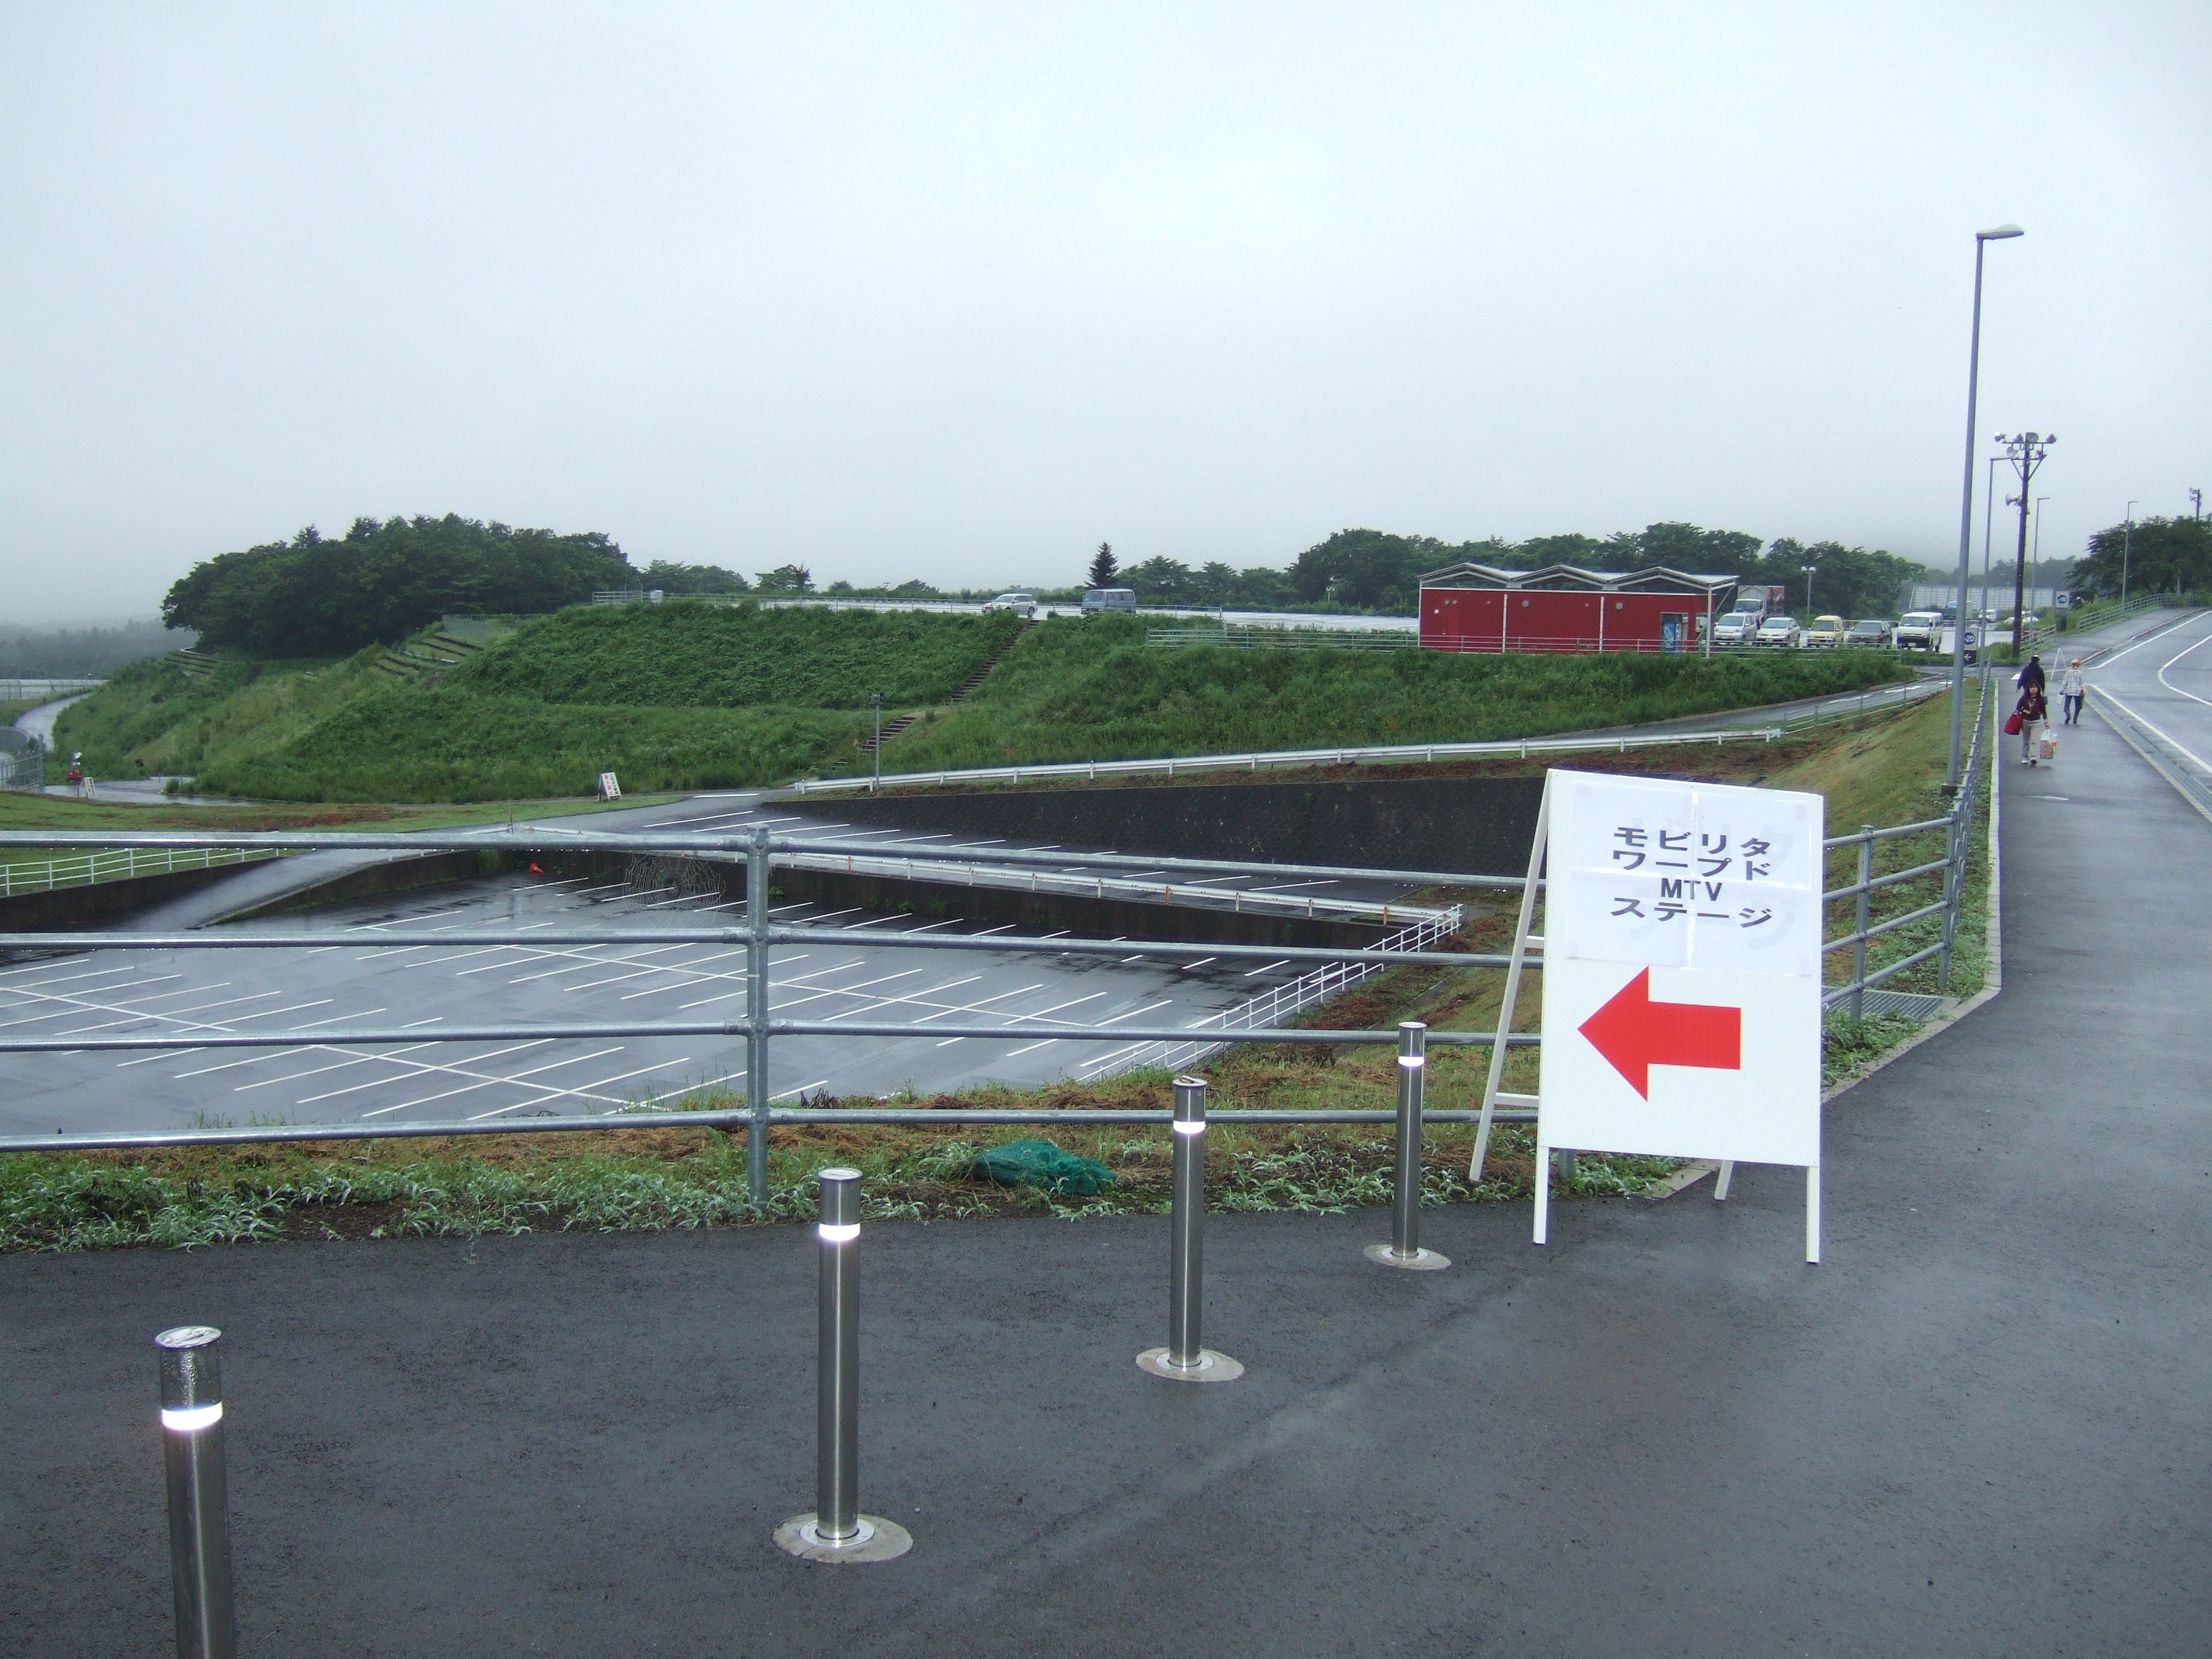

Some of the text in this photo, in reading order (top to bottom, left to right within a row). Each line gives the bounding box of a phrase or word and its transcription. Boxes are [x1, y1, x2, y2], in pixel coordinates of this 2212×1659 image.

[1614, 826, 1771, 857] モビリタ
[1612, 850, 1771, 881] ワープド
[1661, 878, 1723, 902] MTV
[1610, 897, 1772, 928] ステージ
